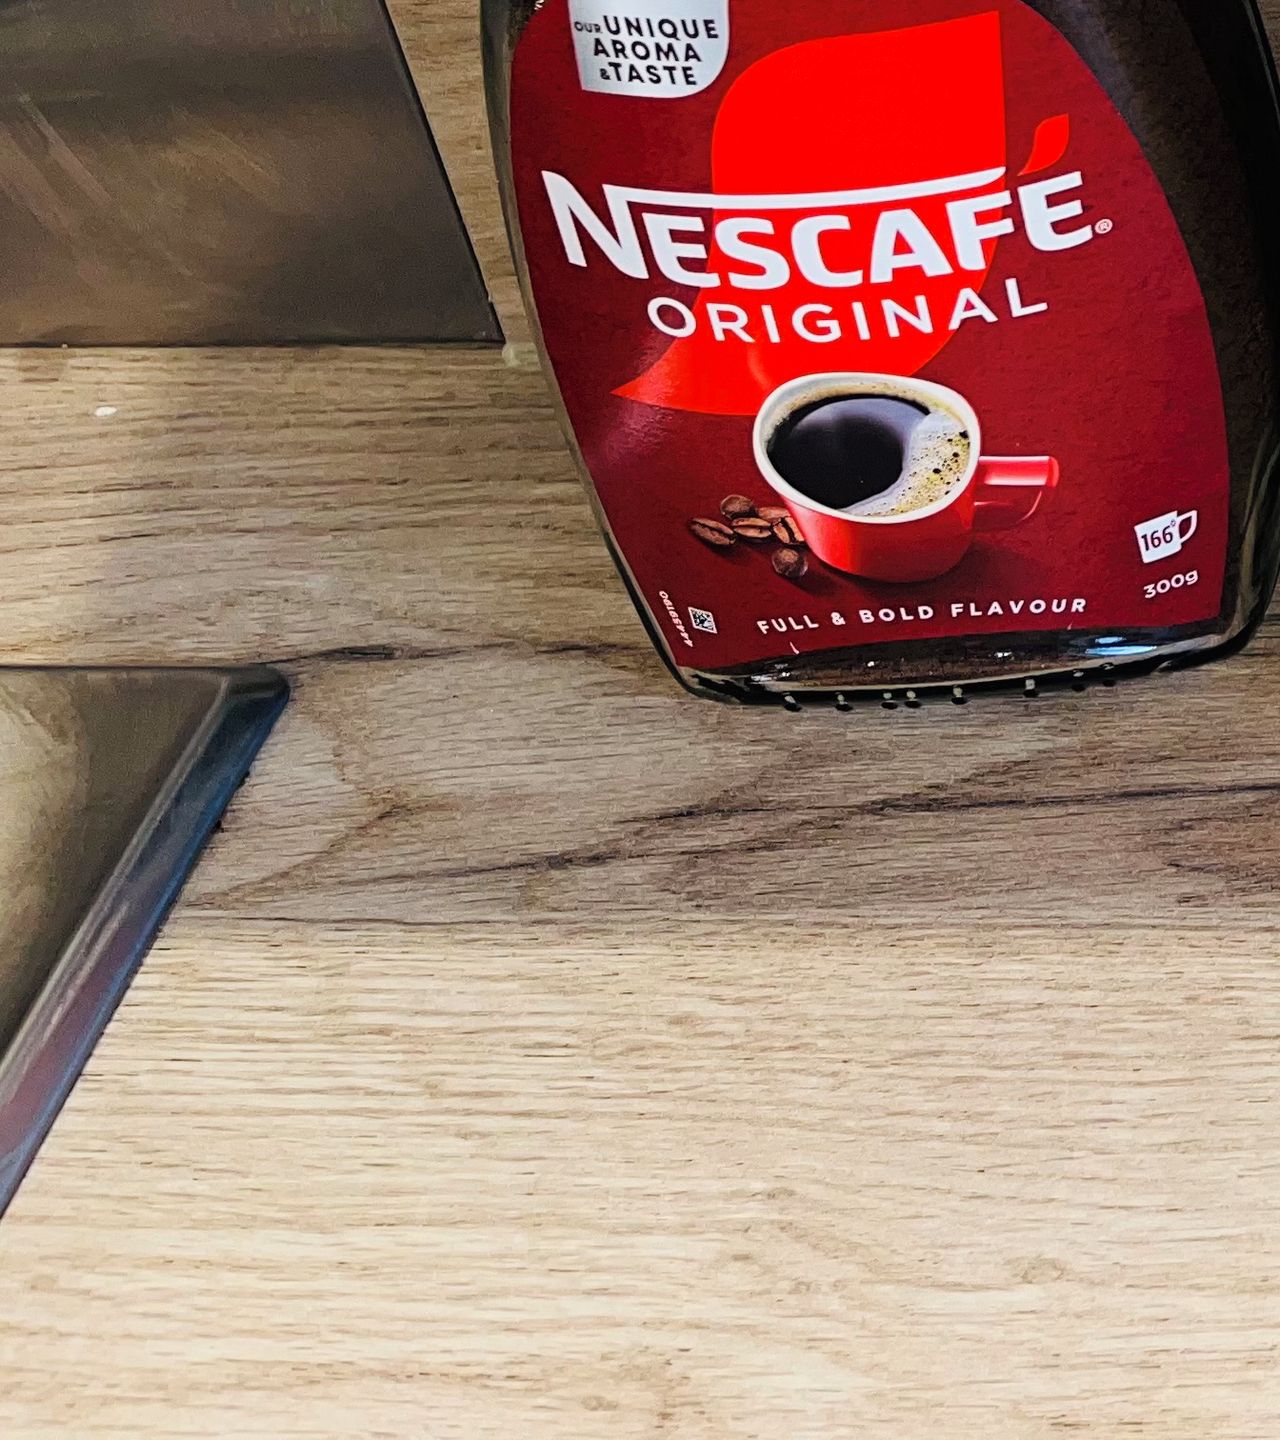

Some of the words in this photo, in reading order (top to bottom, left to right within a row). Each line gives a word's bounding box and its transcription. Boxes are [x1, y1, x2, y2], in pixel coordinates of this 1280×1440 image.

[574, 21, 603, 34] OUR
[603, 15, 719, 41] UNIQUE
[593, 37, 702, 62] AROMA
[646, 277, 1049, 344] ORIGINAL
[1141, 525, 1174, 552] 166
[1143, 570, 1198, 599] 300g
[757, 614, 819, 635] FULL
[831, 612, 846, 626] &
[859, 606, 934, 623] BOLD
[951, 598, 1086, 618] FLAVOUR
